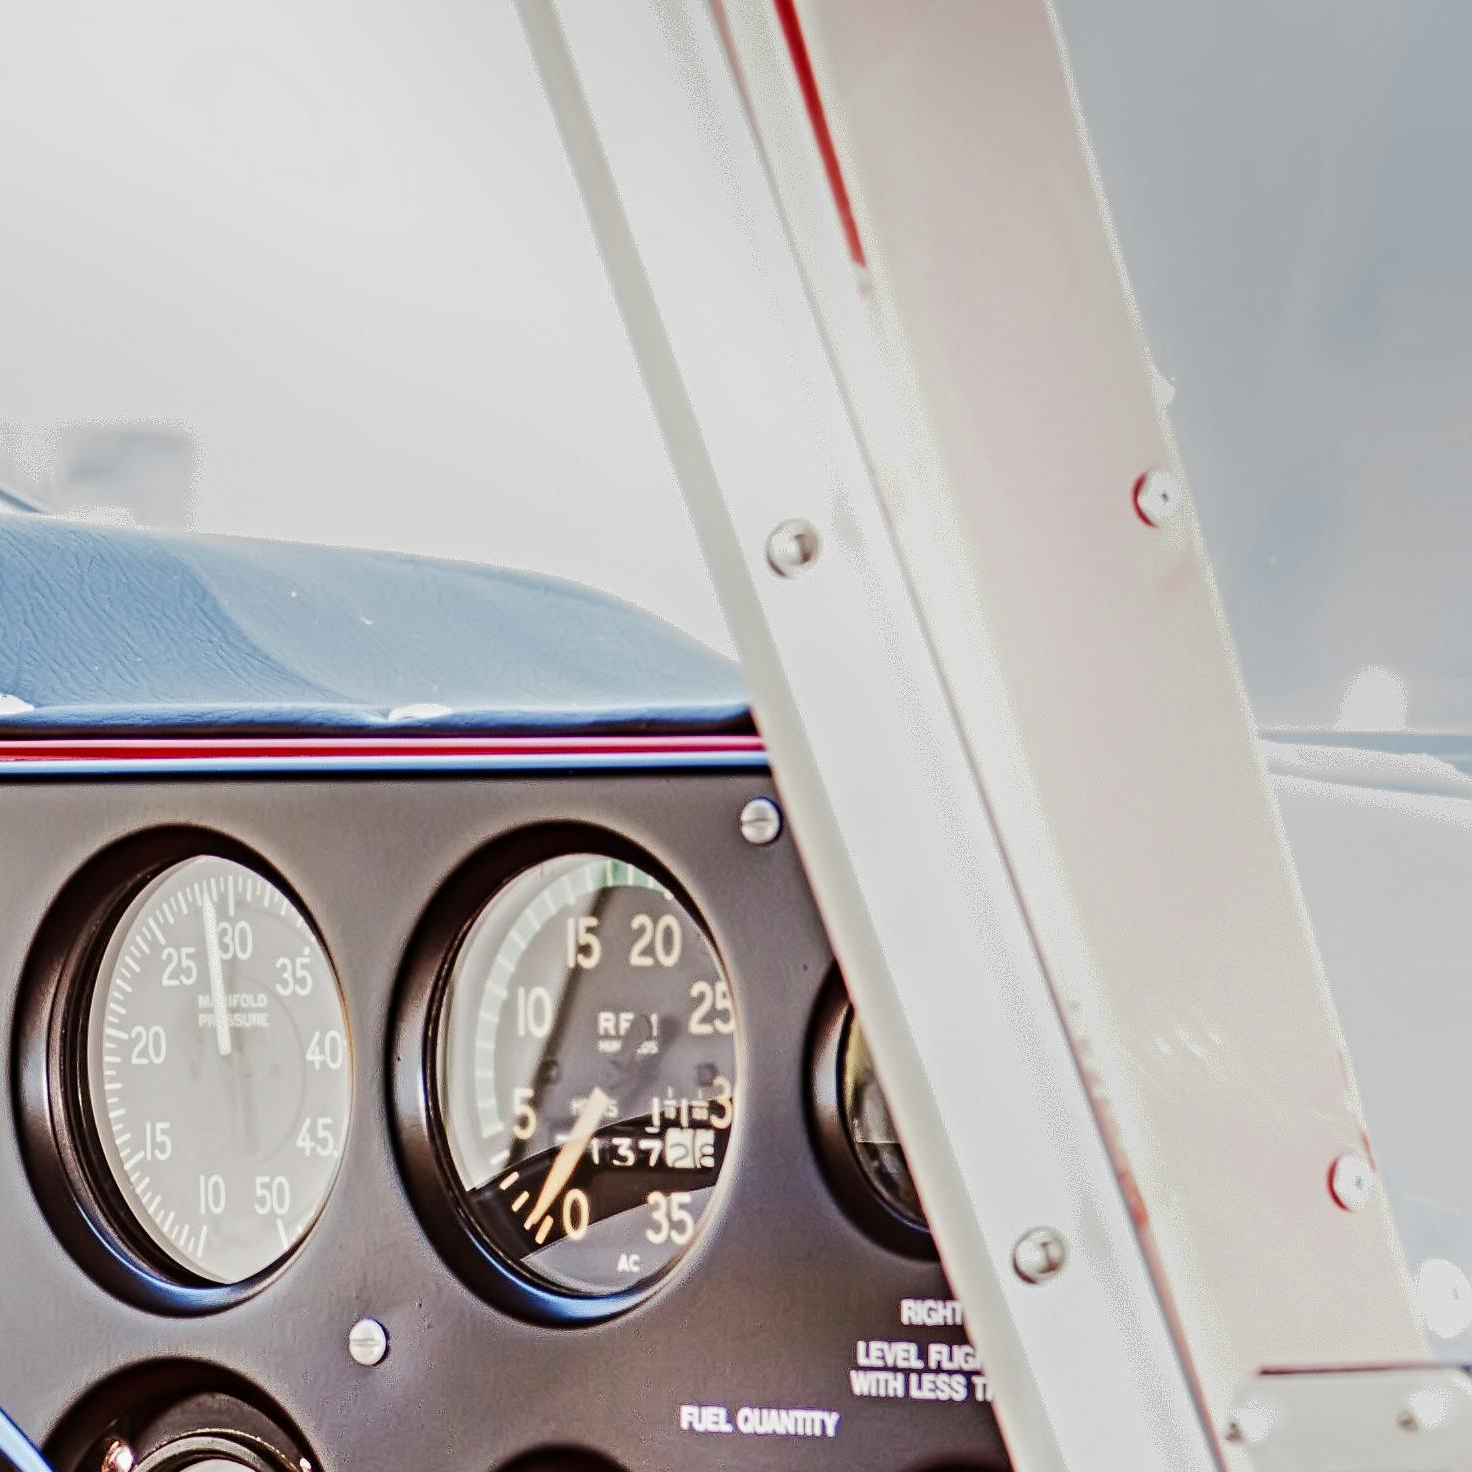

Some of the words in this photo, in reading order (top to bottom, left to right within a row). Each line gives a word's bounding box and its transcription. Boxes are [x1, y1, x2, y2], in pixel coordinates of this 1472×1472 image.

[216, 921, 253, 961] 30
[566, 915, 602, 970] 15
[628, 913, 682, 969] 20
[162, 946, 197, 987] 25
[275, 956, 314, 997] 35
[198, 993, 269, 1008] MAIFOLD
[199, 1012, 270, 1028] PRSSURE
[517, 986, 552, 1039] 10
[688, 980, 735, 1036] 25
[130, 1025, 167, 1065] 20
[304, 1030, 344, 1070] 40
[512, 1087, 537, 1140] 5
[144, 1121, 172, 1161] 15
[296, 1118, 335, 1158] 45
[199, 1174, 226, 1215] 10
[254, 1175, 290, 1216] 50
[563, 1189, 589, 1241] 0
[646, 1190, 695, 1246] 35
[617, 1254, 642, 1274] AC
[901, 1298, 964, 1327] RIGHT
[856, 1340, 924, 1370] LEVEL
[850, 1370, 905, 1399] WITH
[909, 1373, 968, 1402] LESS
[679, 1404, 734, 1434] FUEL
[736, 1407, 841, 1439] QUANTITY
